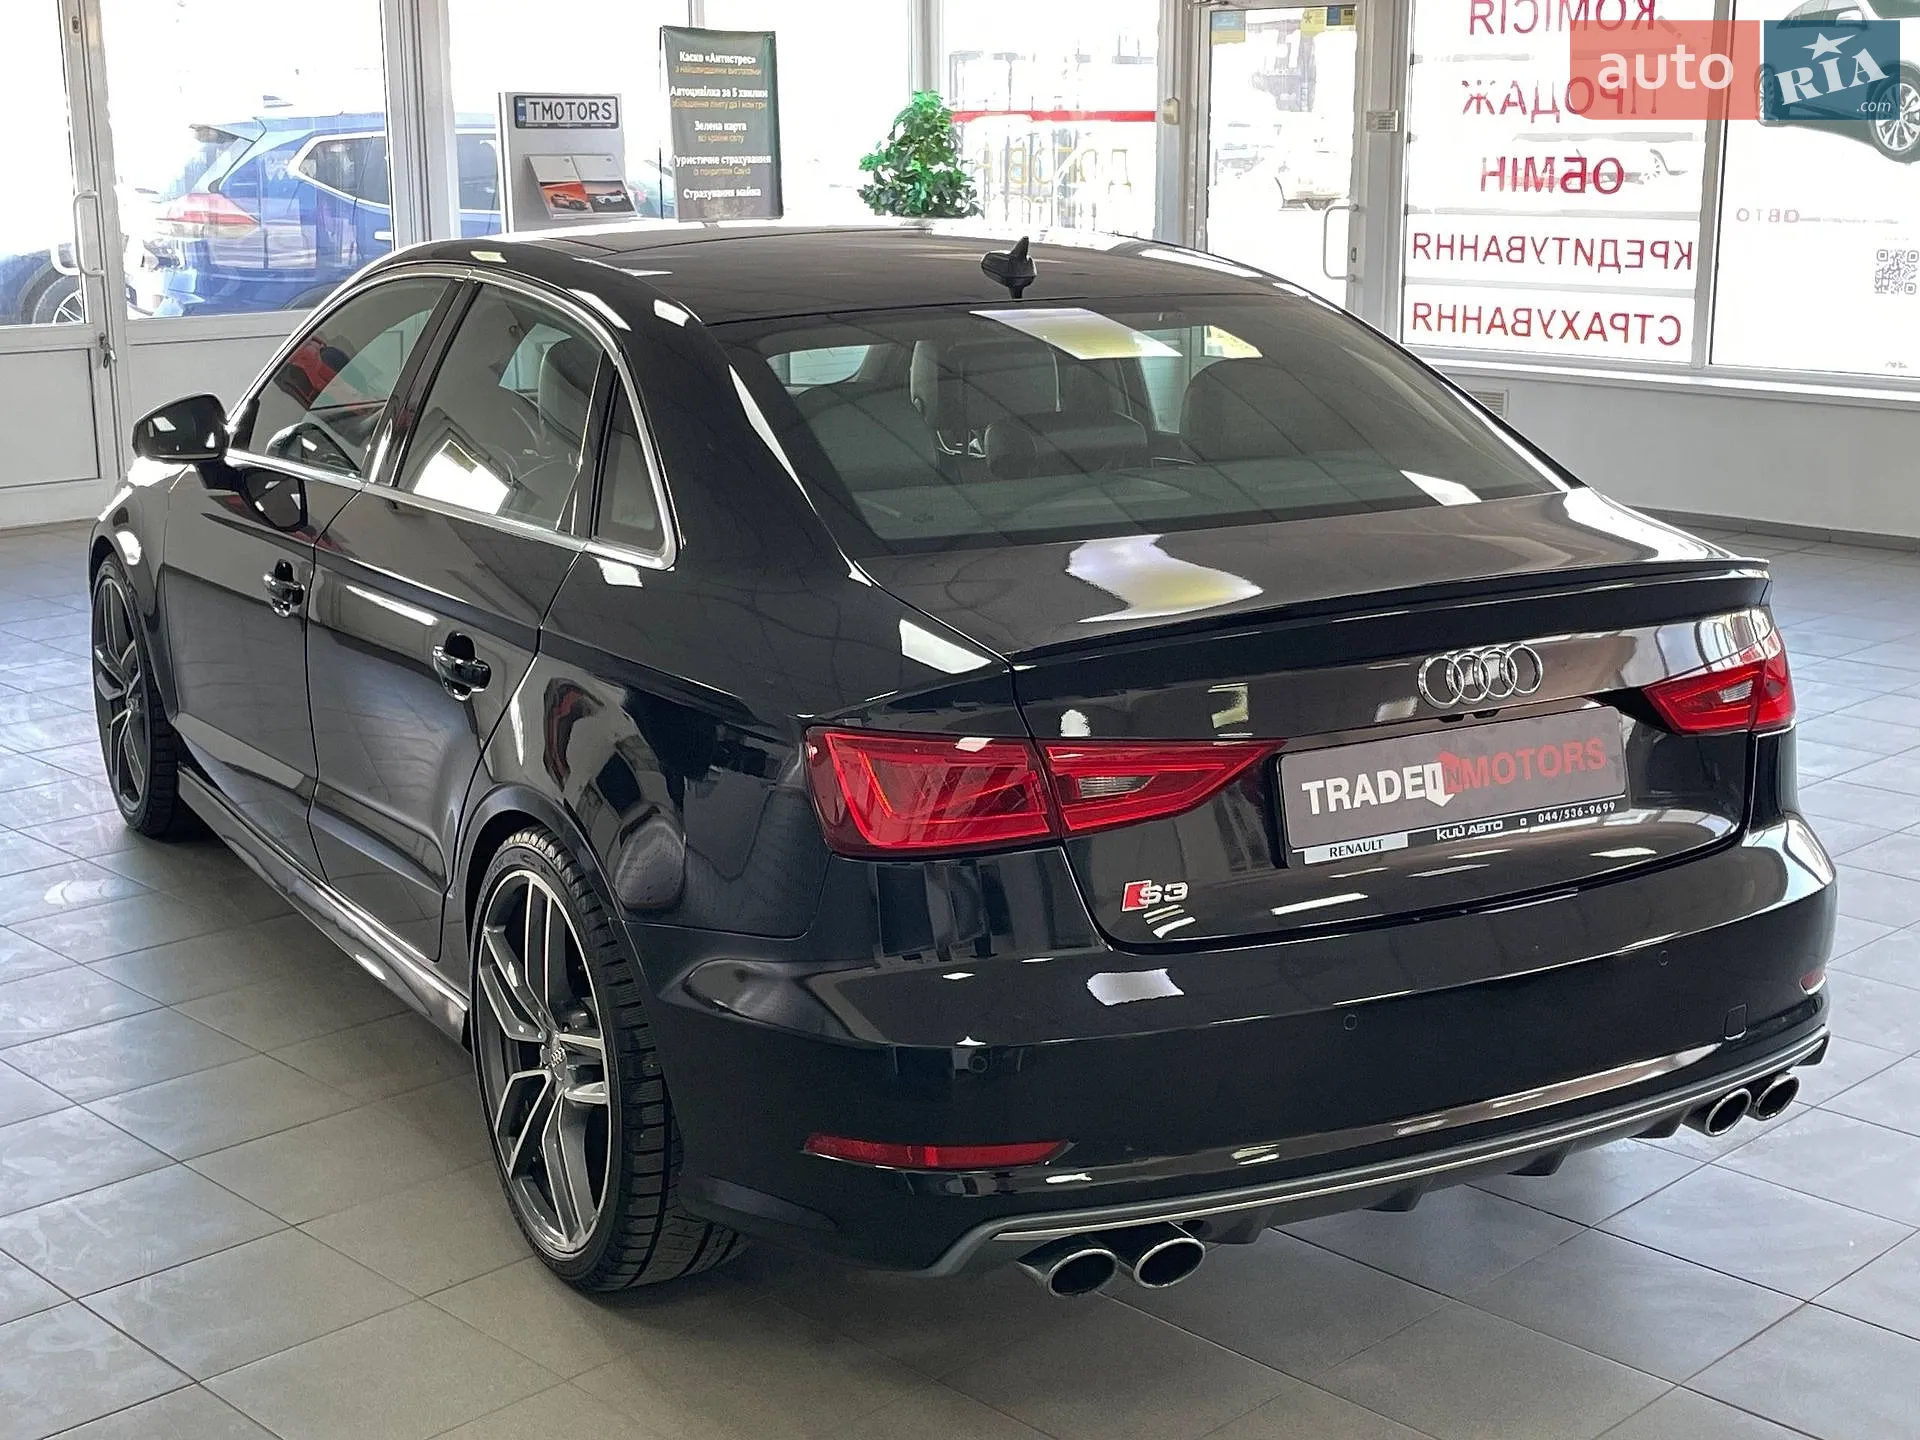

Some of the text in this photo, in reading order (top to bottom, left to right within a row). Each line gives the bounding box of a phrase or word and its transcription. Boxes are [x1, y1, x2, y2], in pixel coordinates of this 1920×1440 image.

[529, 101, 612, 121] TMOTORS
[1538, 801, 1616, 824] 044/536-9699
[1329, 839, 1384, 858] RENAULT
[1138, 882, 1189, 905] S3
